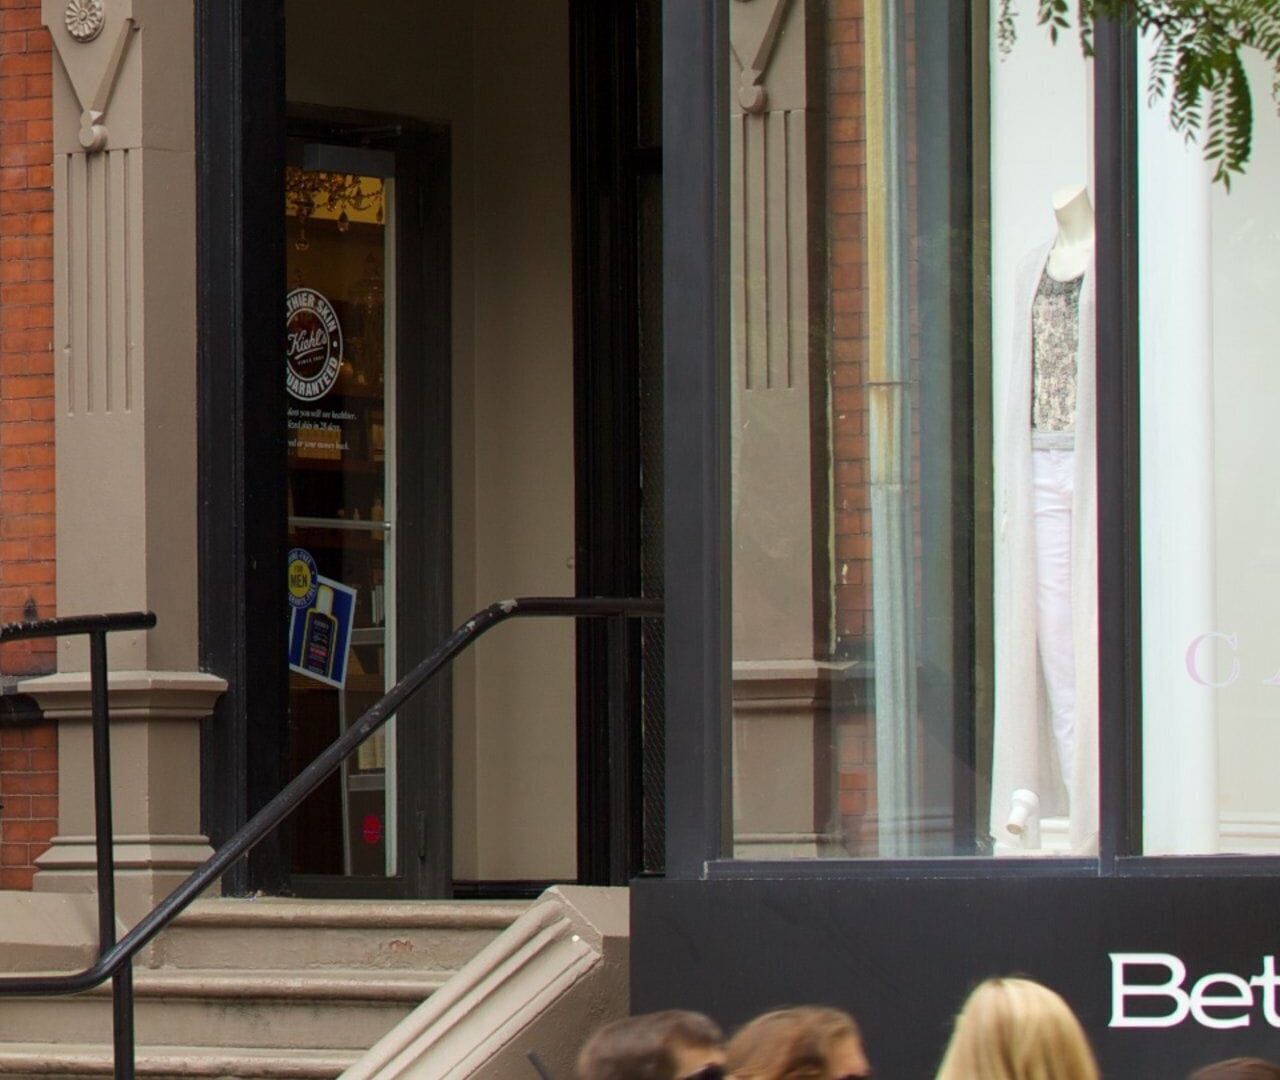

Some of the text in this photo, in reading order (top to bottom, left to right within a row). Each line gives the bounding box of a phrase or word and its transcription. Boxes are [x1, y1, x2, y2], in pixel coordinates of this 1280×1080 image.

[317, 300, 337, 333] SKIN
[287, 329, 327, 358] Kiehl's
[291, 575, 308, 588] MEN
[1108, 952, 1280, 1030] Bet
